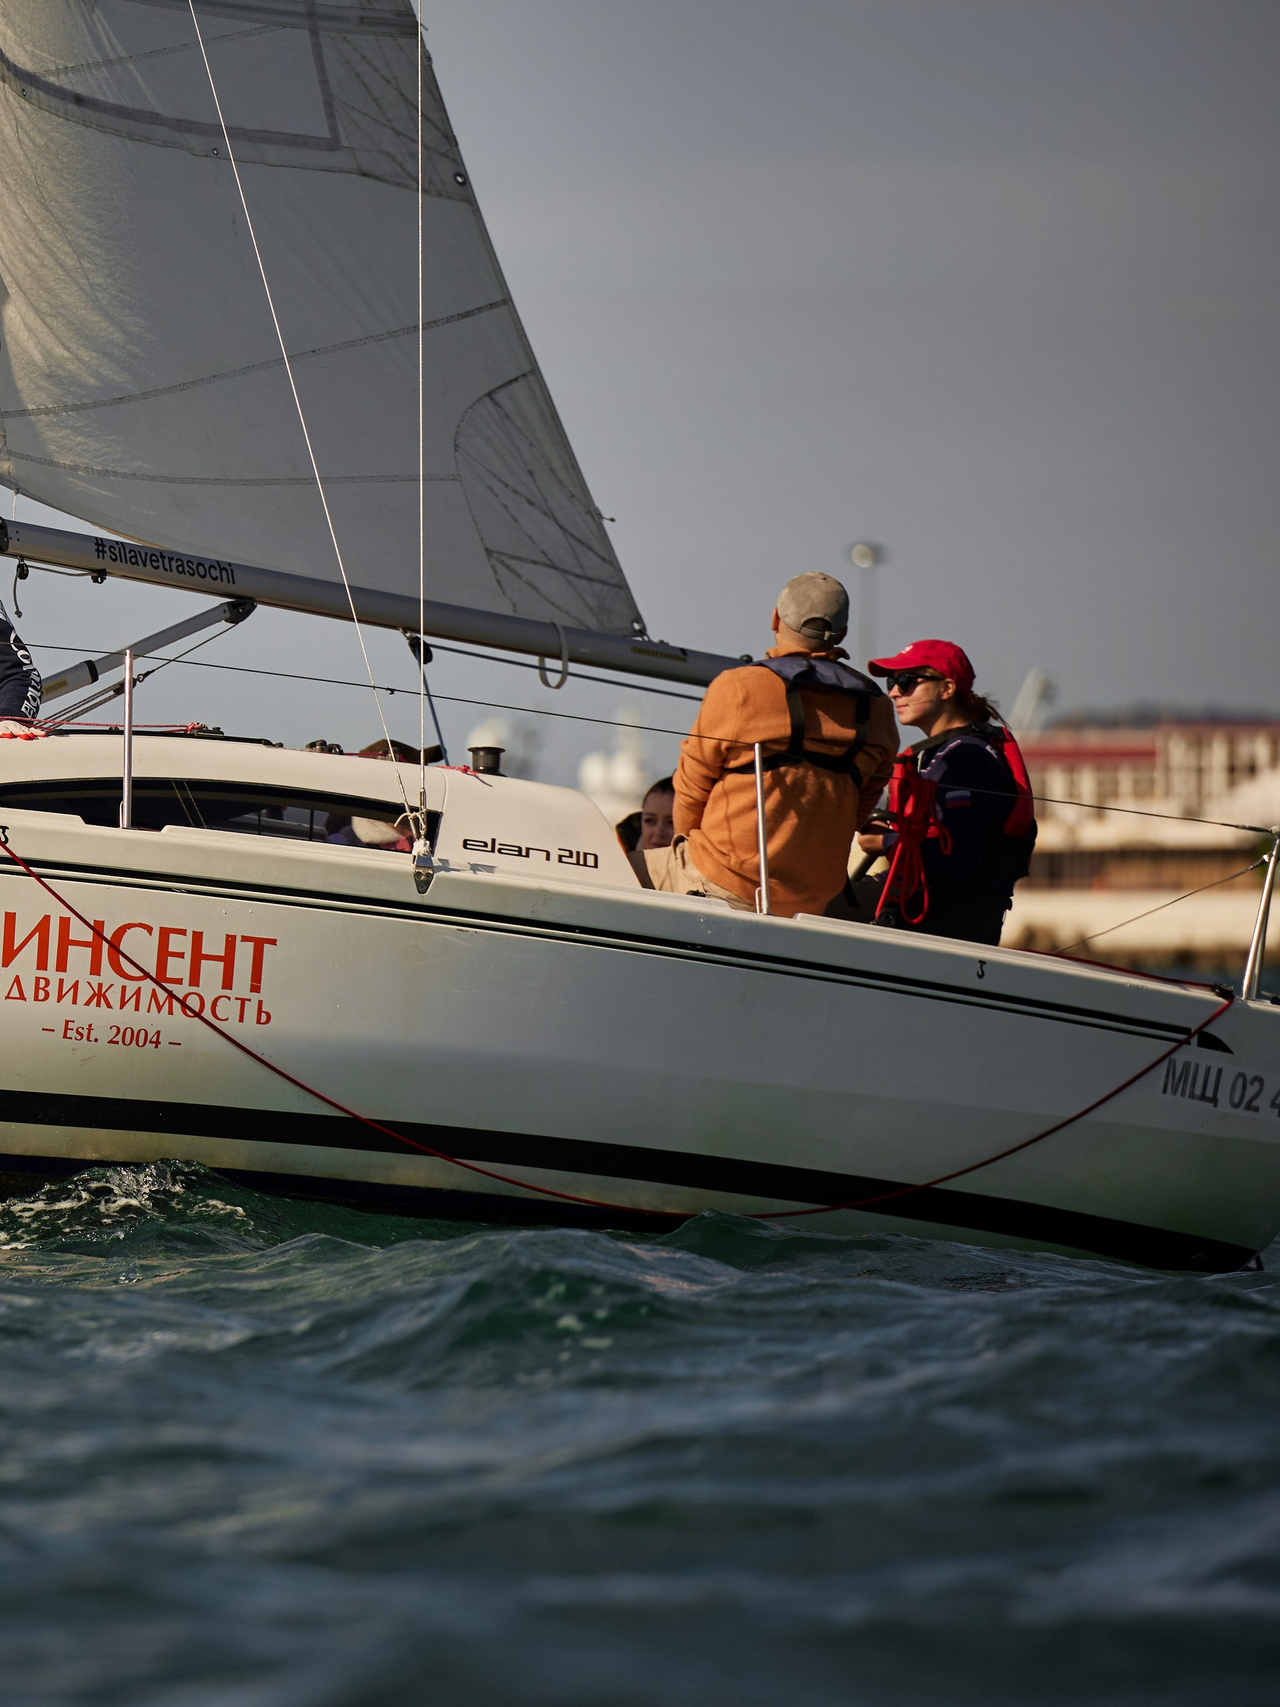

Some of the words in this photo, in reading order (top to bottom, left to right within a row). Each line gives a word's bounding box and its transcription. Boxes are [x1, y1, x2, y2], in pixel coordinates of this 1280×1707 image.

[94, 537, 236, 584] #silavetrasochi
[462, 837, 551, 862] elan
[557, 847, 599, 869] 210
[62, 1019, 99, 1043] Est.
[107, 1025, 162, 1049] 2004
[1162, 1057, 1223, 1108] МЩ
[1229, 1071, 1265, 1113] 02
